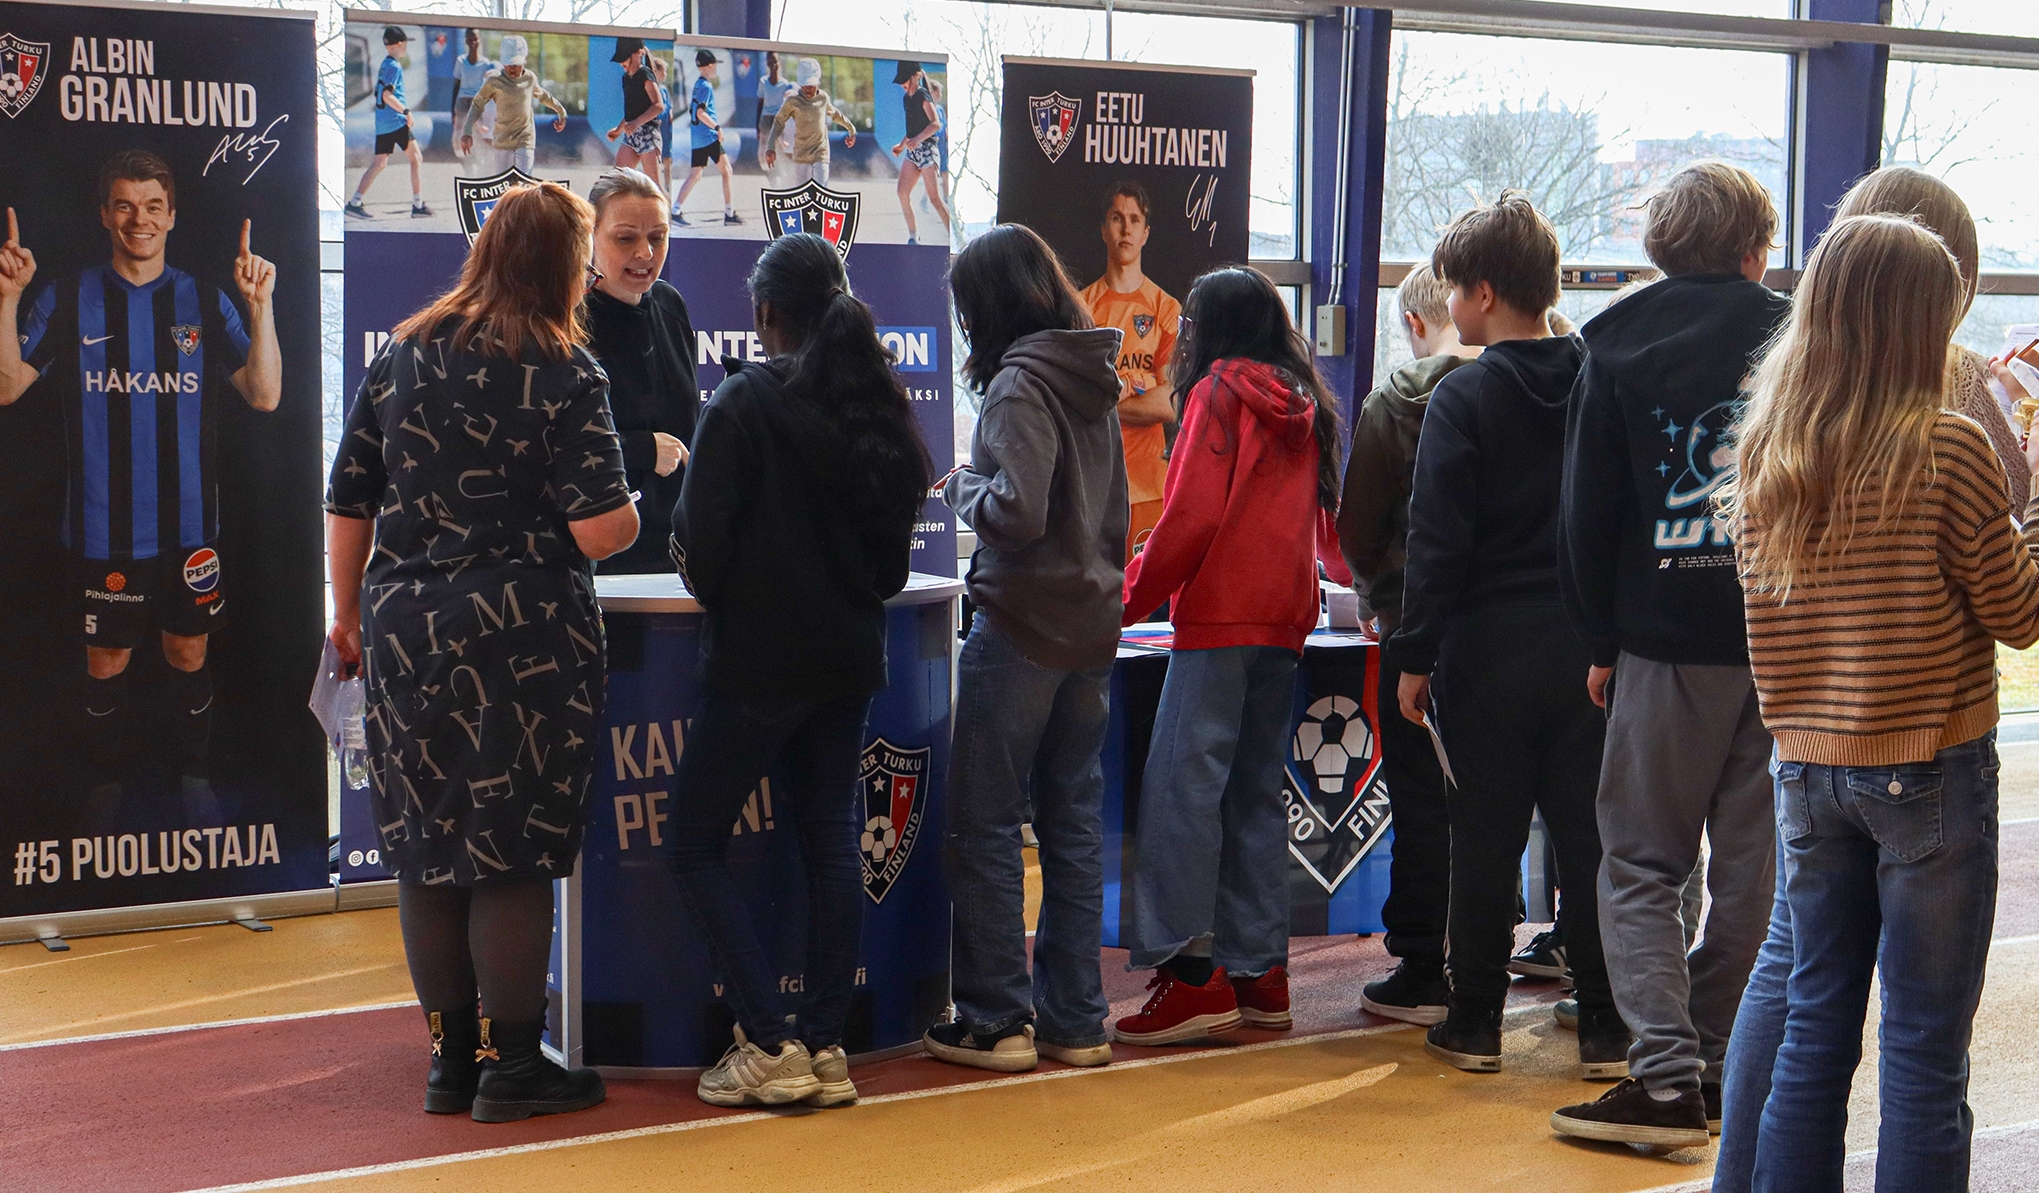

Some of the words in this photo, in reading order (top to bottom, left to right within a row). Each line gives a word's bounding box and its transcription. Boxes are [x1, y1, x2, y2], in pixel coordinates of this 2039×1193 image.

[12, 40, 42, 55] TURKU
[70, 36, 154, 75] ALBIN
[15, 75, 41, 109] FINLAND
[60, 75, 257, 128] GRANLUND
[1040, 97, 1055, 107] INTER
[1057, 97, 1077, 109] TURKU
[1096, 91, 1144, 125] EETU
[1055, 126, 1074, 155] FINLAND
[1084, 124, 1227, 167] HUUHTANEN
[463, 188, 477, 199] FC
[480, 180, 511, 199] INTER
[769, 199, 782, 209] FC
[783, 191, 811, 209] INTER
[815, 192, 849, 211] TURKU
[85, 368, 199, 394] HÅKANS
[186, 560, 218, 579] PEPSI
[85, 589, 145, 602] Pihlajalinna
[85, 614, 97, 634] 5
[883, 752, 922, 772] TURKU
[14, 840, 61, 885] #5
[72, 823, 280, 881] PUOLUSTAJA
[883, 812, 920, 883] FINLAND
